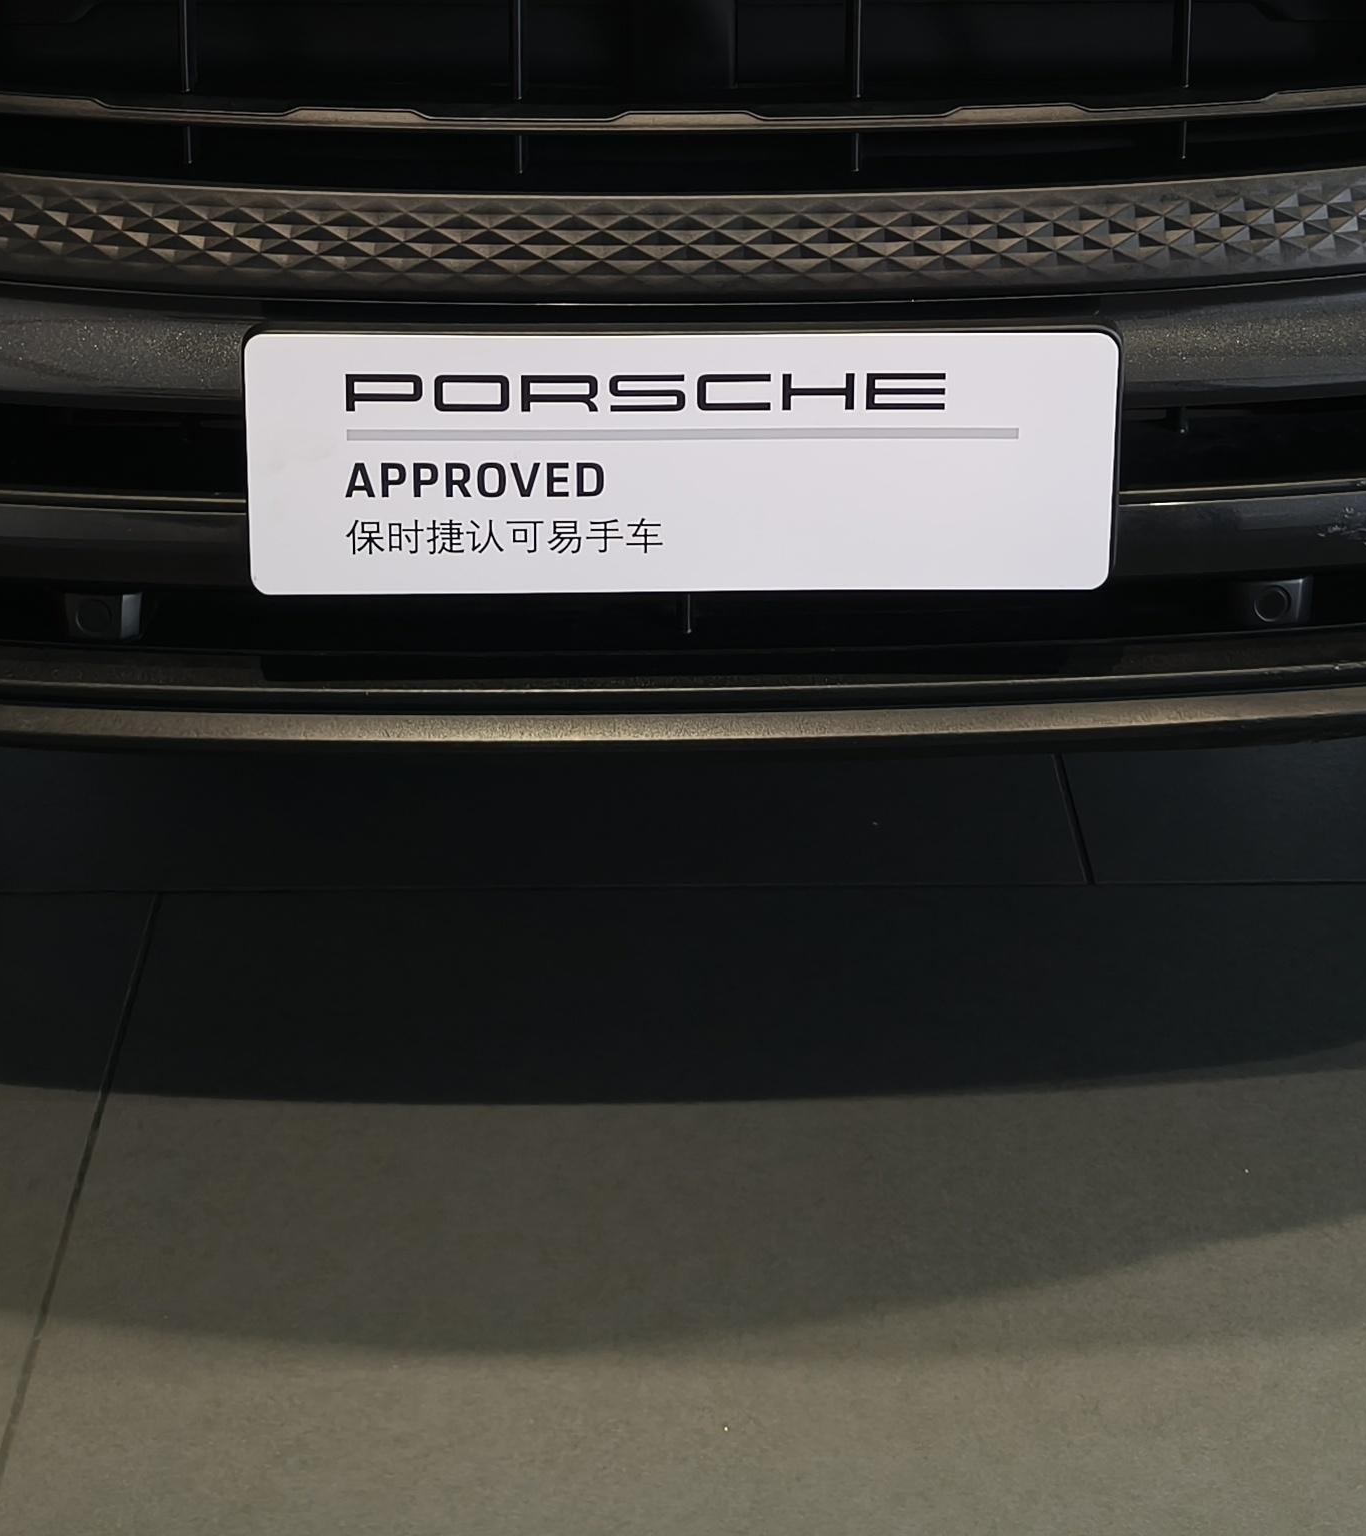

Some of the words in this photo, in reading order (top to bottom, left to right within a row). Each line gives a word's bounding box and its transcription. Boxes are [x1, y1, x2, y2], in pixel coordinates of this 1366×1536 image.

[344, 372, 947, 413] PORSCHE
[344, 462, 605, 498] APPROVED
[345, 517, 664, 555] 保时捷认可易手车
